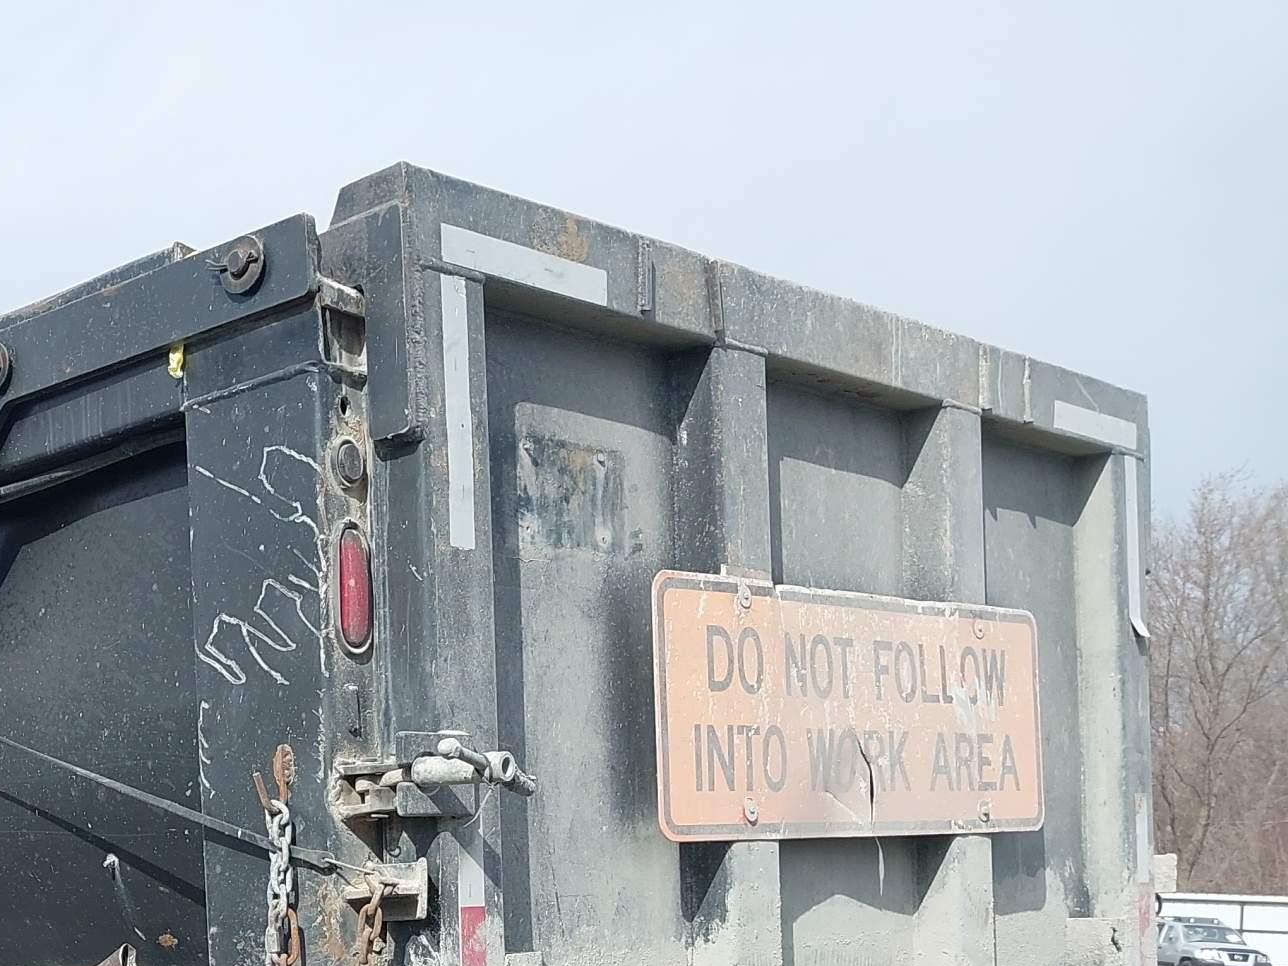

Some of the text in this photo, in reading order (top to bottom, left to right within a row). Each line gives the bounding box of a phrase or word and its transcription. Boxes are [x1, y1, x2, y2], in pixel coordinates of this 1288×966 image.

[706, 625, 1006, 707] DO NOT FOLLOW
[694, 723, 1021, 793] INTO WORK AREA
